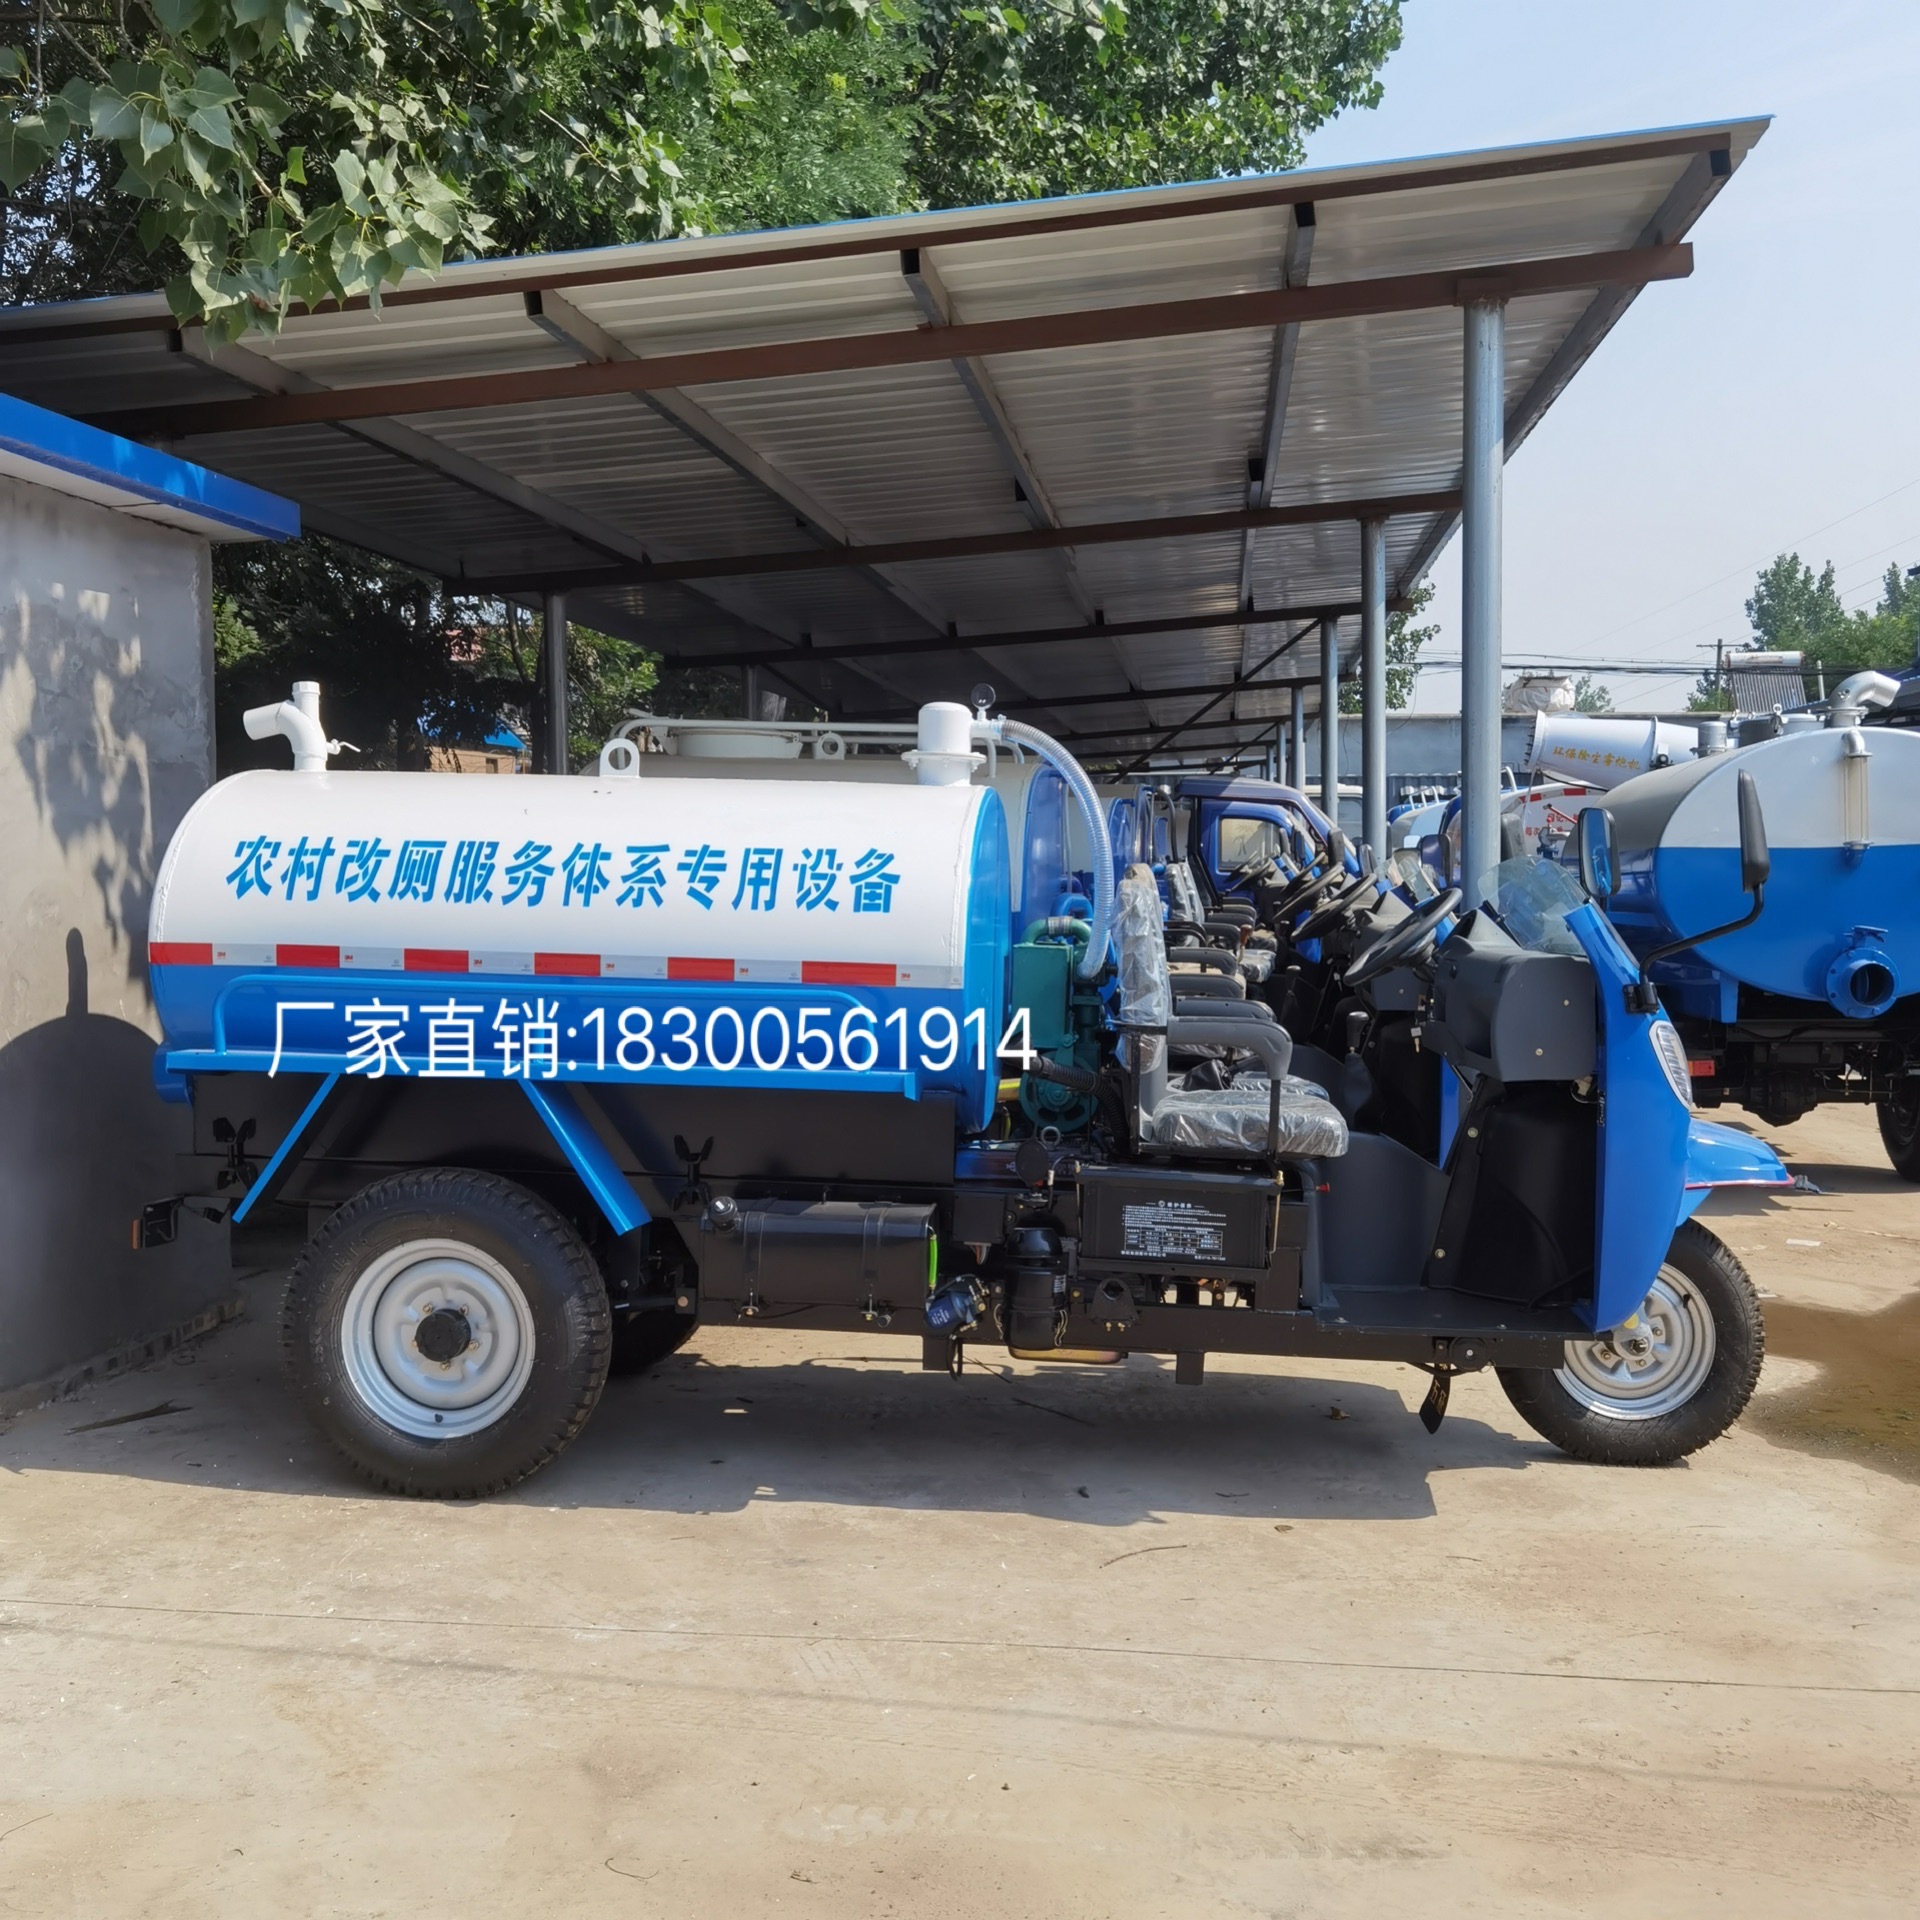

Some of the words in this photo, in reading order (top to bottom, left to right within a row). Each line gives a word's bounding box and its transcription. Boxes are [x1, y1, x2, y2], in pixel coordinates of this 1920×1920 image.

[225, 834, 902, 913] 农村改厕服务体系专用设备
